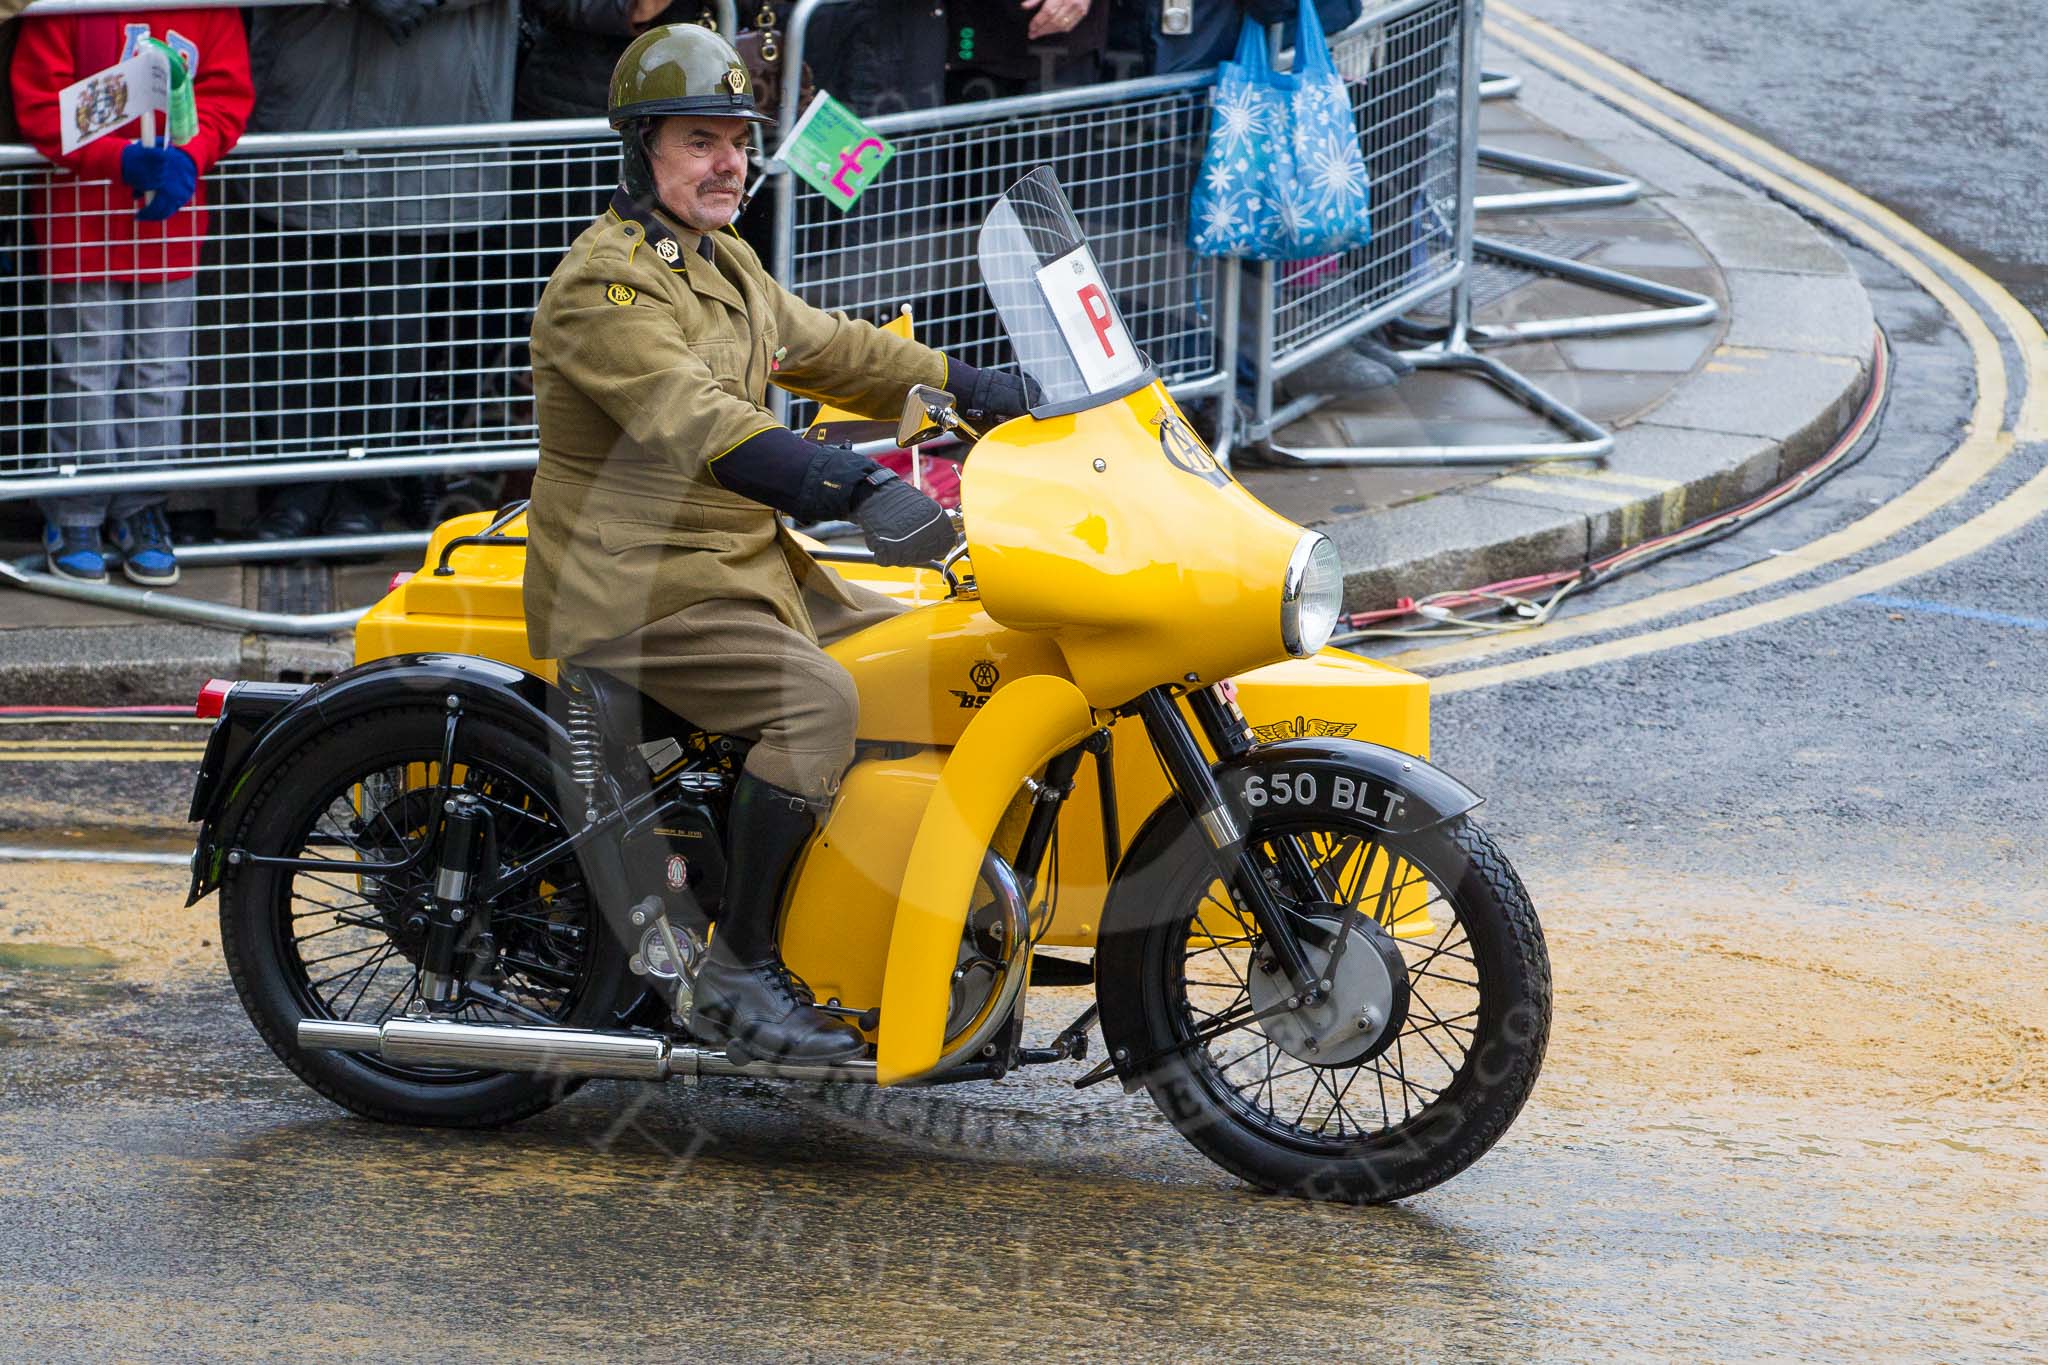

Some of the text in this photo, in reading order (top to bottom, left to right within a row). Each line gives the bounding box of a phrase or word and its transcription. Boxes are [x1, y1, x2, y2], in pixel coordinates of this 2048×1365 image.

[831, 137, 885, 198] £
[1075, 282, 1116, 360] P
[959, 693, 992, 709] BS
[1245, 772, 1406, 823] 650 BLT
